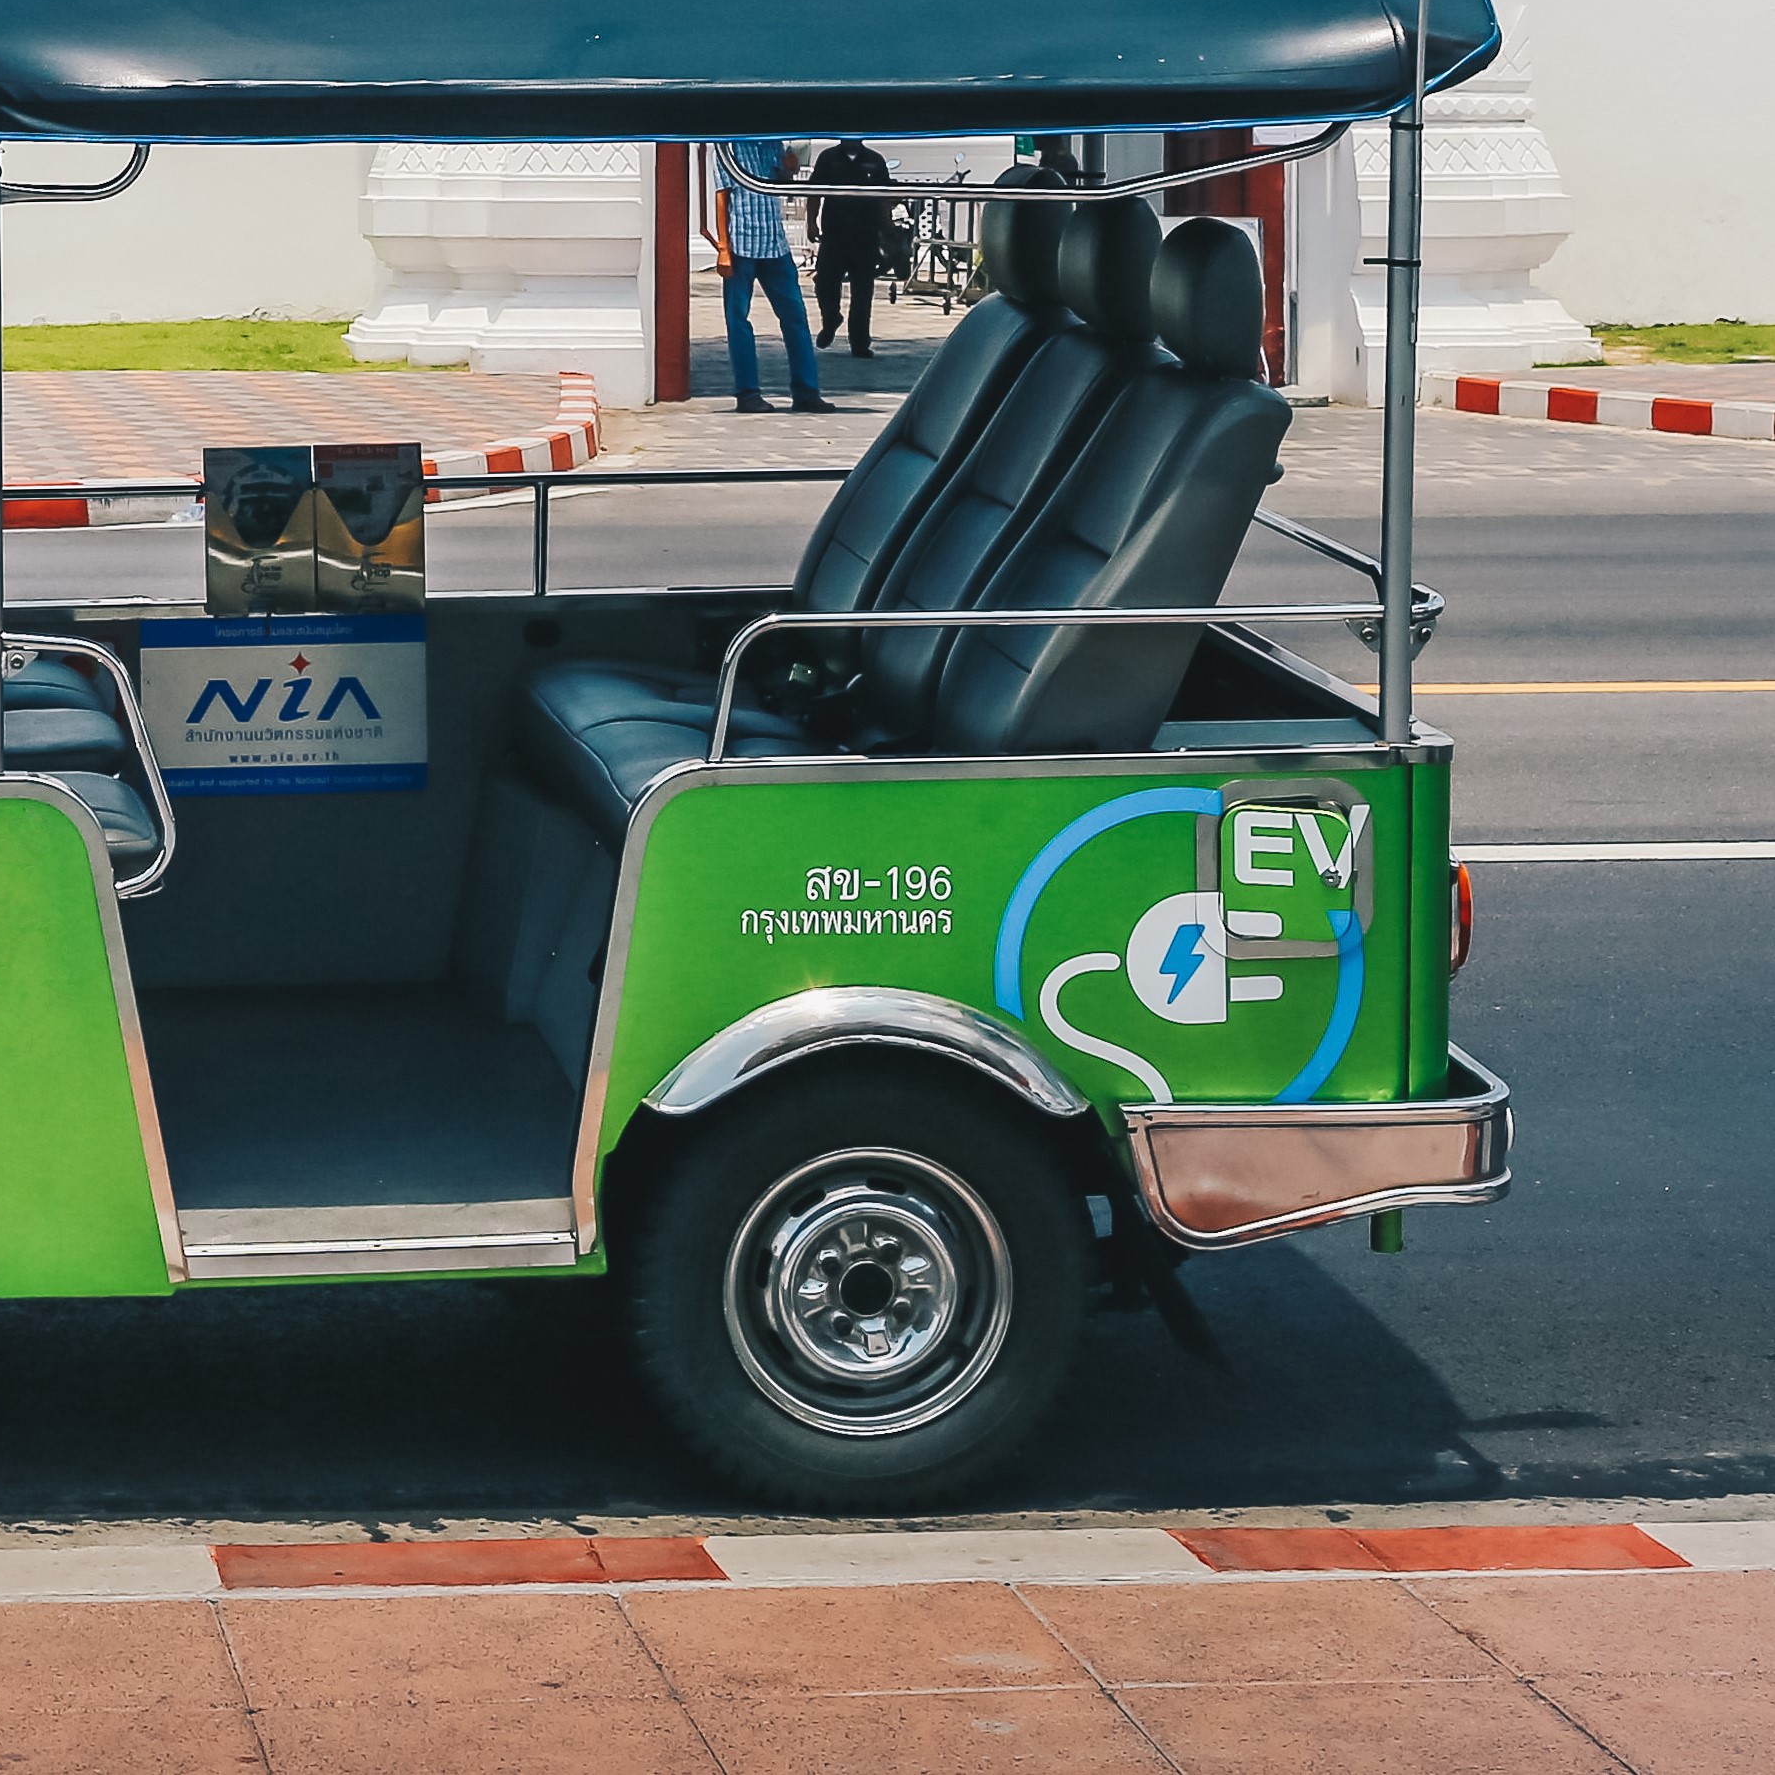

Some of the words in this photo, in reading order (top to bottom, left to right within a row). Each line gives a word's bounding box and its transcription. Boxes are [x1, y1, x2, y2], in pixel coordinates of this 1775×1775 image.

[229, 750, 340, 764] www.nia.or.th
[1234, 804, 1371, 890] EV
[806, 865, 952, 900] สข-196
[740, 909, 953, 944] กรุงเทพมหานคร
